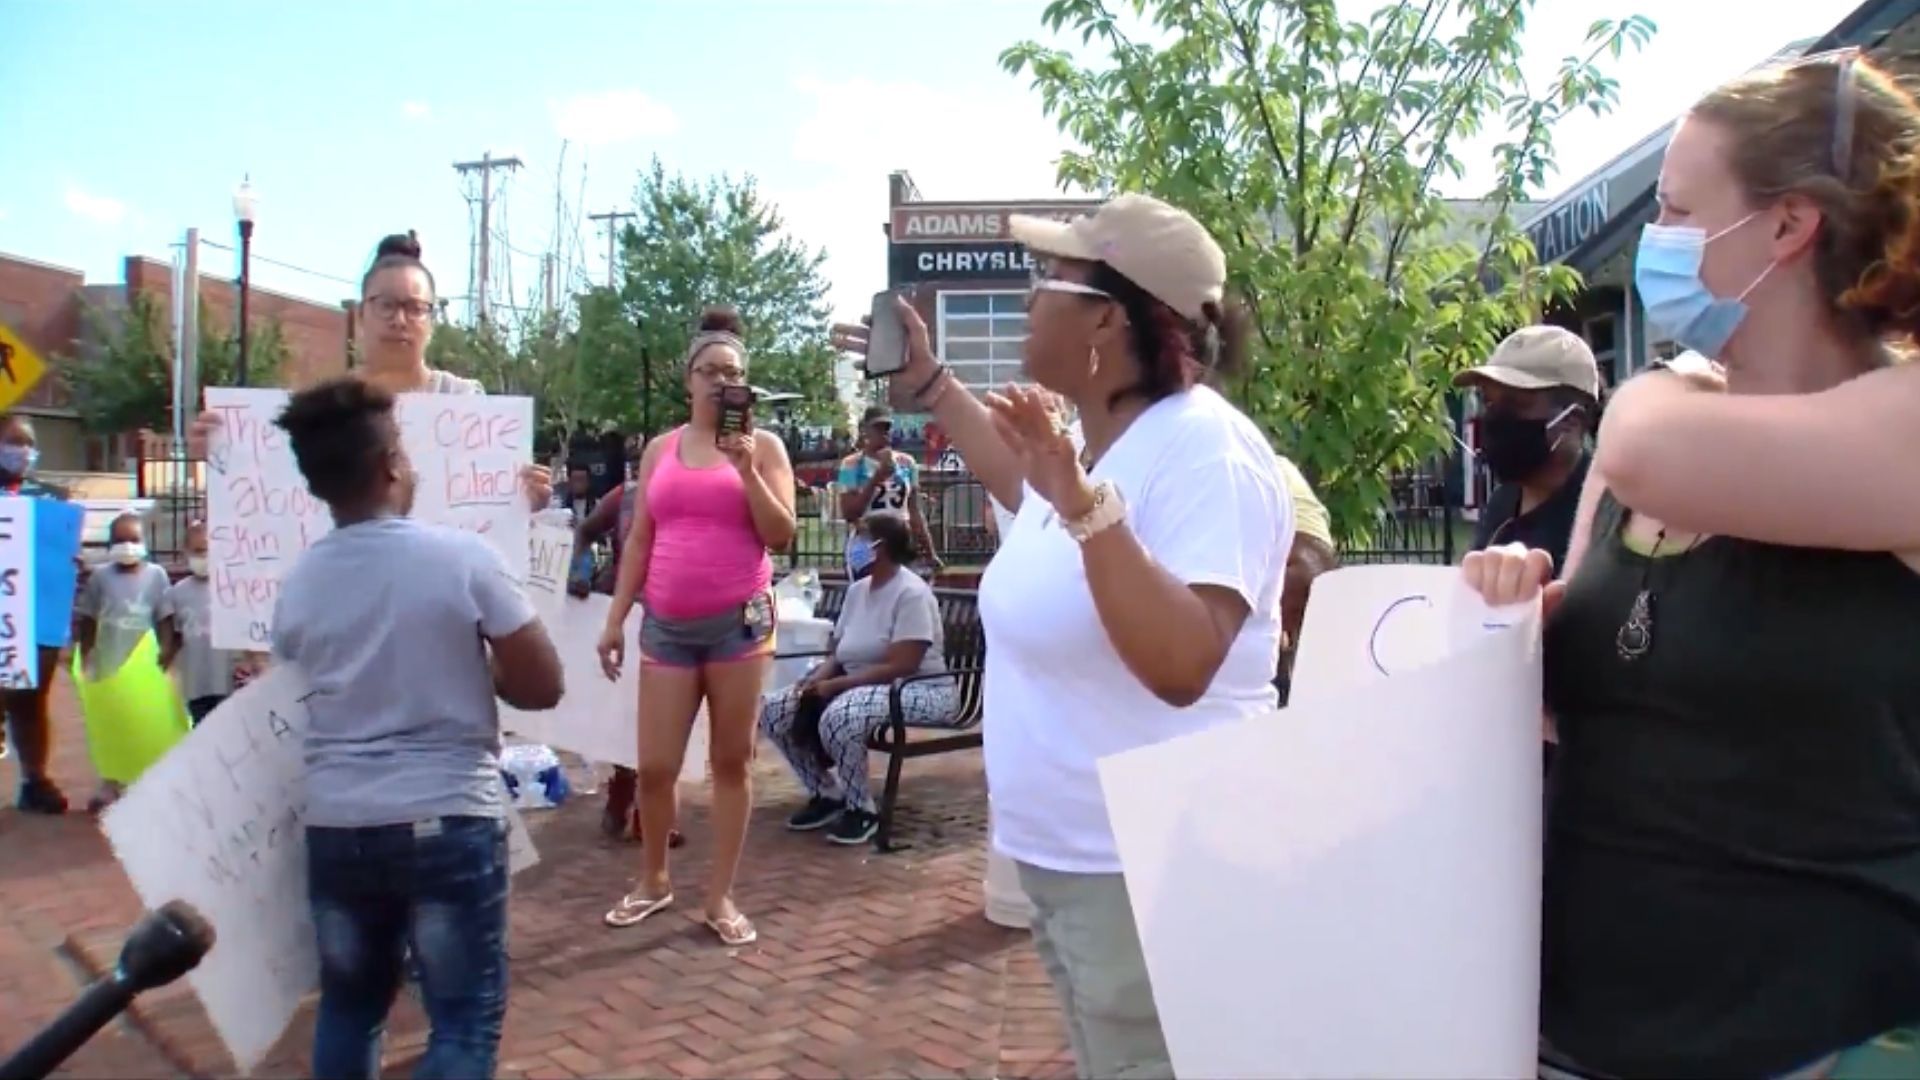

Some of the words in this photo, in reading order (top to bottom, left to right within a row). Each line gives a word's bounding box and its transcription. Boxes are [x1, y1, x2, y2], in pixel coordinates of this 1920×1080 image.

[905, 214, 1001, 235] ADAMS
[1532, 180, 1609, 262] TATION
[917, 251, 1037, 272] CHRYSLE
[871, 479, 906, 509] 23
